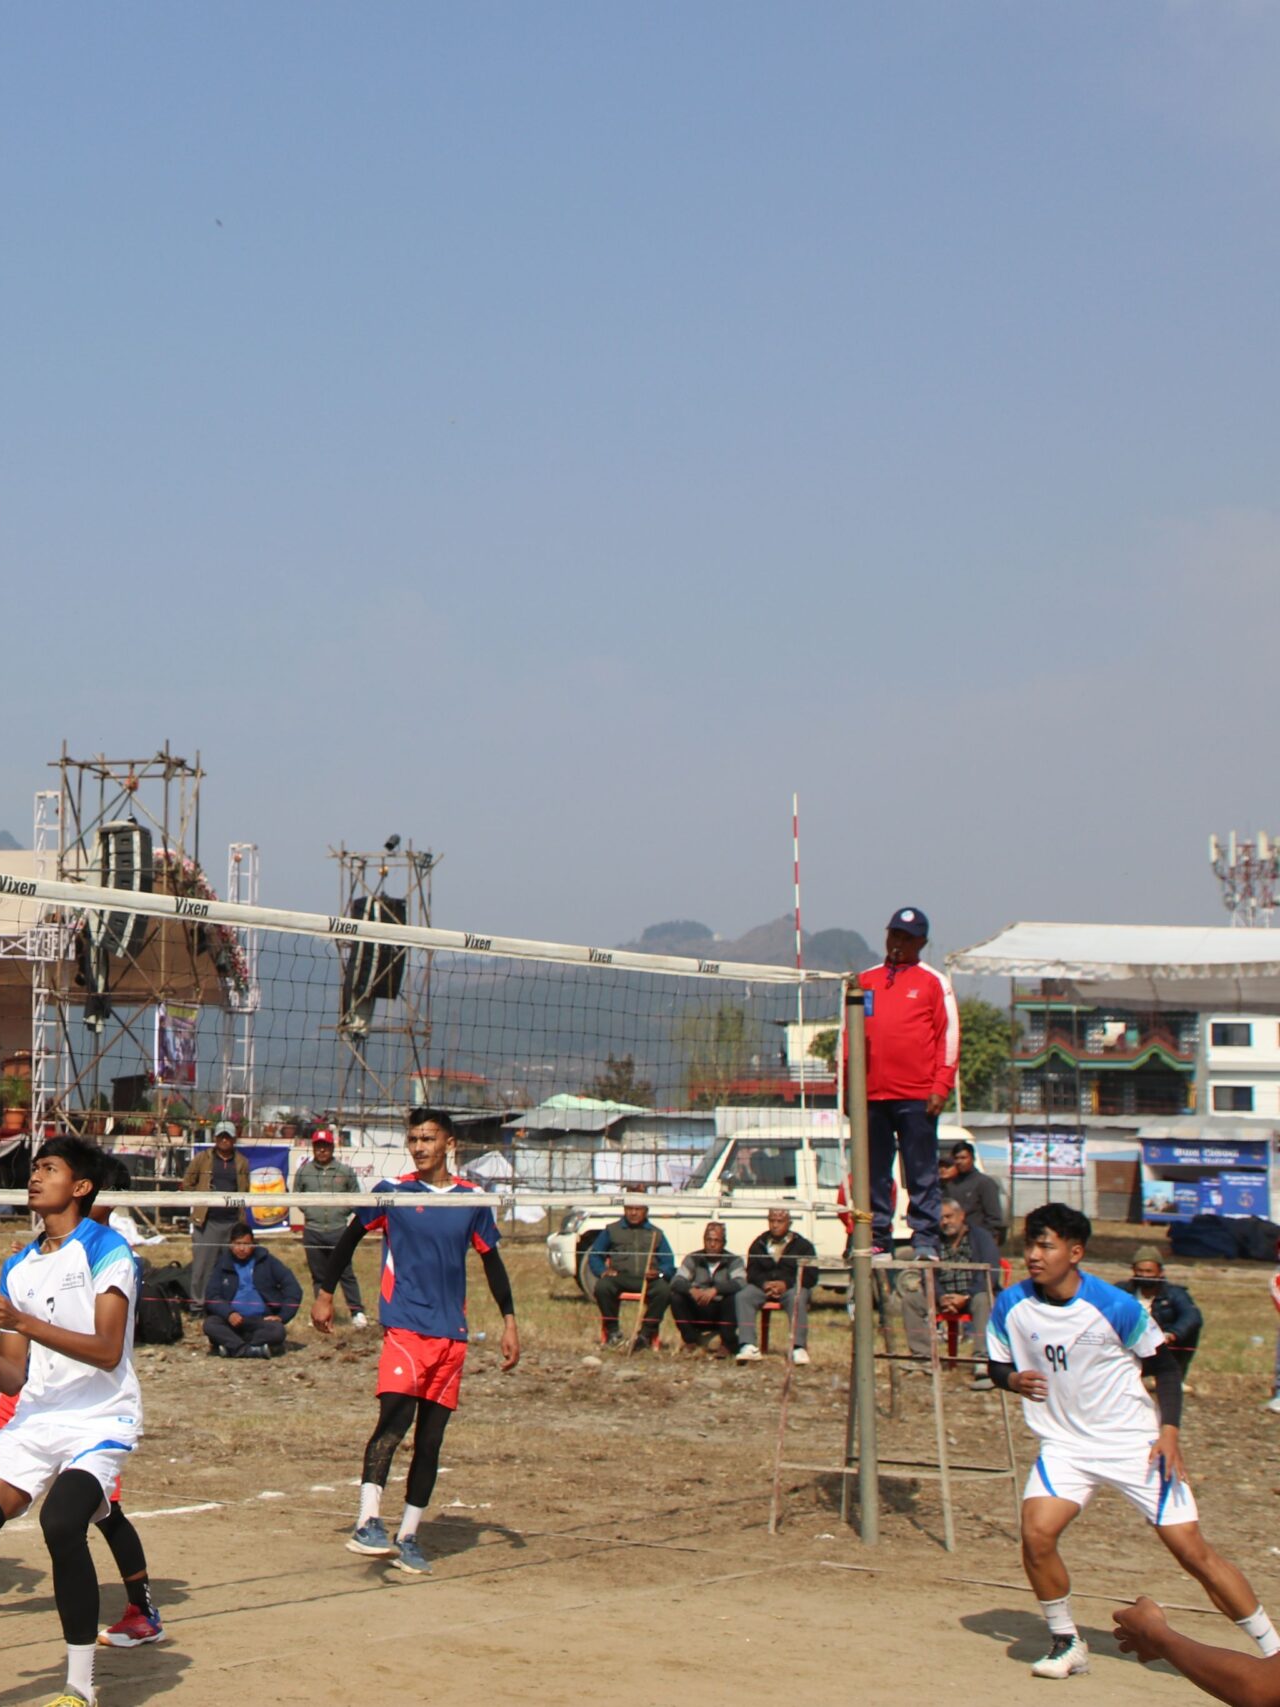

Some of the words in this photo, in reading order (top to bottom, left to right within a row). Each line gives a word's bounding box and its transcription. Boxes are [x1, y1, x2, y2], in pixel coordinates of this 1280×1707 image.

[175, 897, 209, 917] Vixen
[328, 917, 358, 935] Vixen
[464, 933, 491, 951] Vixen
[589, 948, 613, 964] Vixen
[1044, 1343, 1068, 1373] 99
